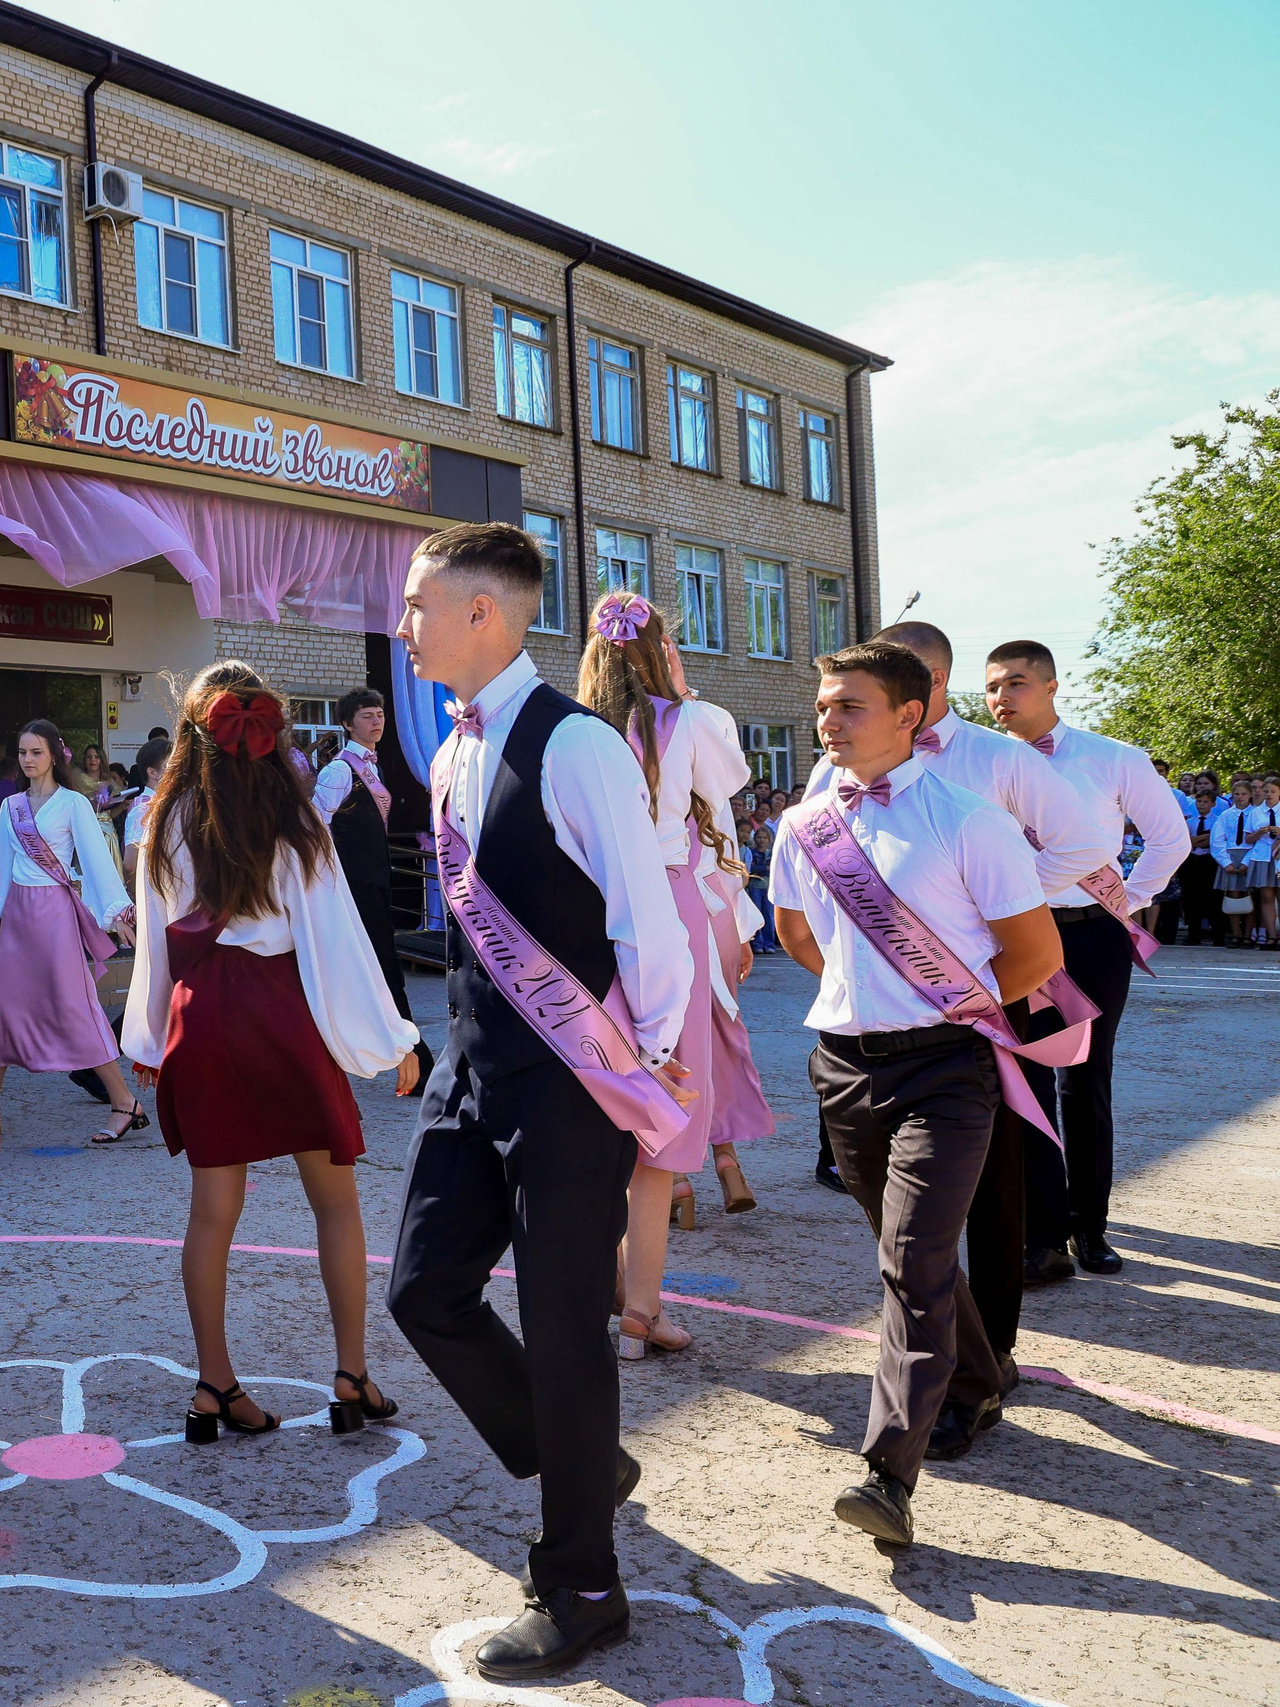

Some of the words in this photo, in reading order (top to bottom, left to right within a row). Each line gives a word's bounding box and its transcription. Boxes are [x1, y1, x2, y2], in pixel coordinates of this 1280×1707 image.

[65, 373, 280, 474] Последний
[283, 424, 394, 498] звонок
[437, 833, 525, 974] Выпускник
[512, 963, 592, 1031] 2024
[481, 898, 520, 945] Никита
[828, 847, 952, 990] Выпускник
[915, 930, 946, 962] Роман
